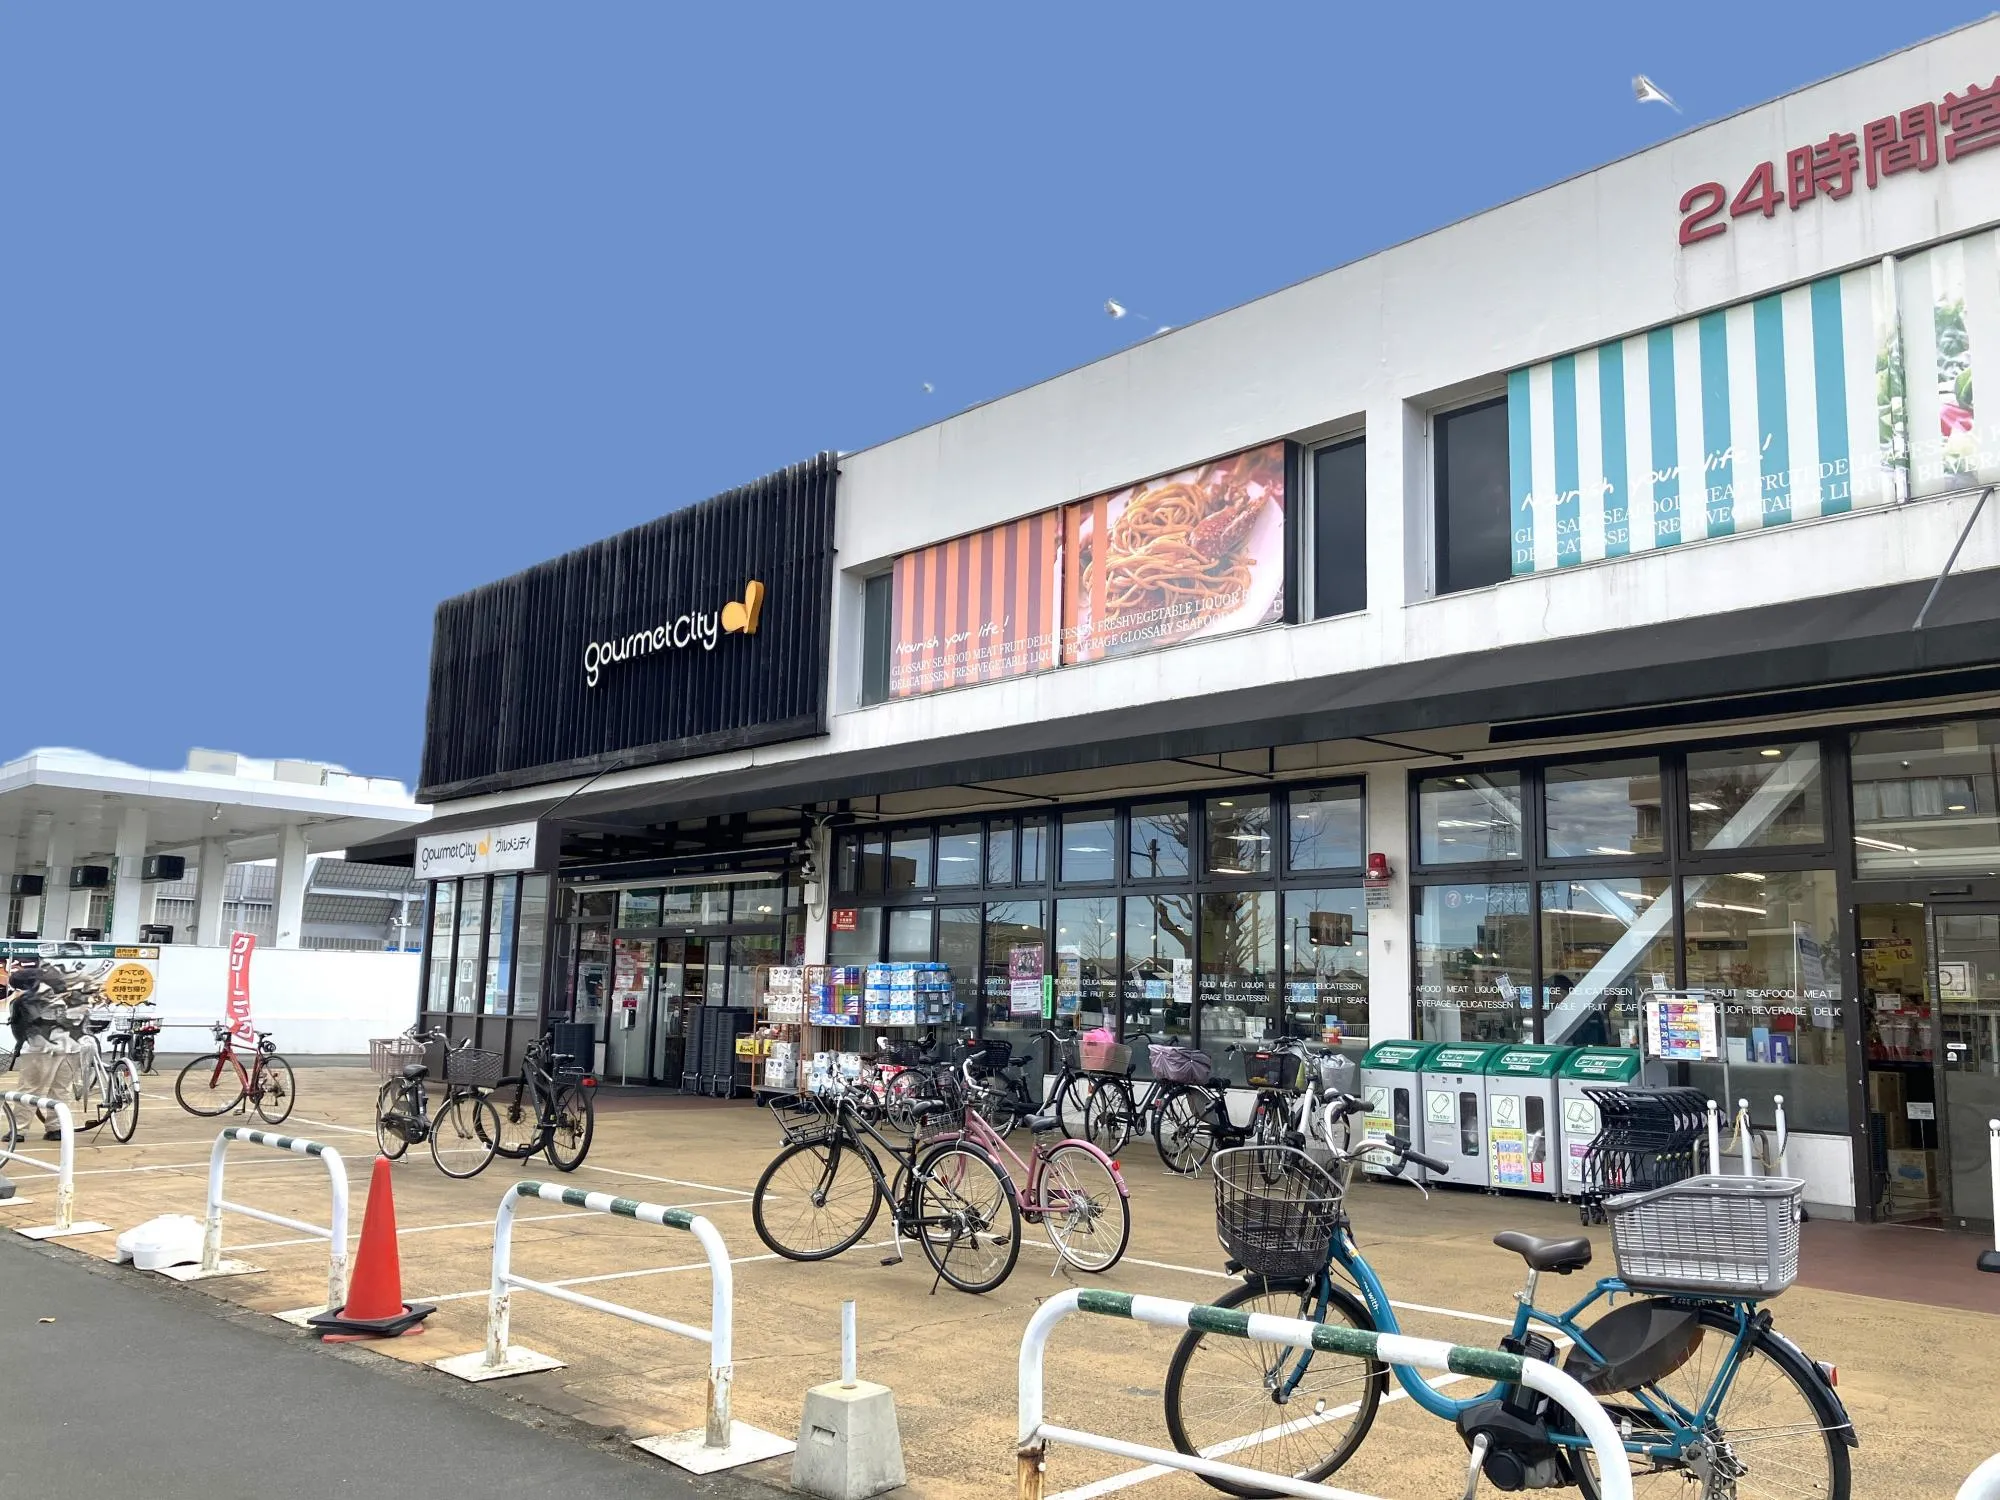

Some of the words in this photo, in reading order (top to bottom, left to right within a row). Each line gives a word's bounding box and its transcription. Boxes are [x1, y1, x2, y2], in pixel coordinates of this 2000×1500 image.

[891, 658, 932, 677] GLOSSARY
[932, 650, 971, 669] SEAFOOD
[973, 644, 1000, 660] MEAT
[1000, 638, 1027, 653] FRUIT
[1098, 600, 1193, 631] FRESHVEGETABLE
[1194, 586, 1240, 612] LIQUOR
[895, 635, 939, 655] Nourish
[945, 631, 971, 647] your
[890, 670, 950, 692] DELICATESSEN
[1066, 634, 1118, 654] BEVERAGE
[1120, 621, 1172, 643] GLOSSARY
[112, 985, 147, 993] お持ち帰り
[113, 977, 148, 985] メニューが
[1219, 981, 1237, 989] MEAT
[1312, 983, 1362, 991] DELICATESSEN
[1446, 985, 1469, 993] MEAT
[1746, 989, 1795, 998] SEAFOOD
[1803, 989, 1833, 999] MEAT
[1224, 994, 1270, 1002] DELICATESSEN
[1322, 996, 1342, 1004] FRUIT
[1456, 1000, 1514, 1009] DELICATESSEN
[1752, 1006, 1807, 1015] BEVERAGE
